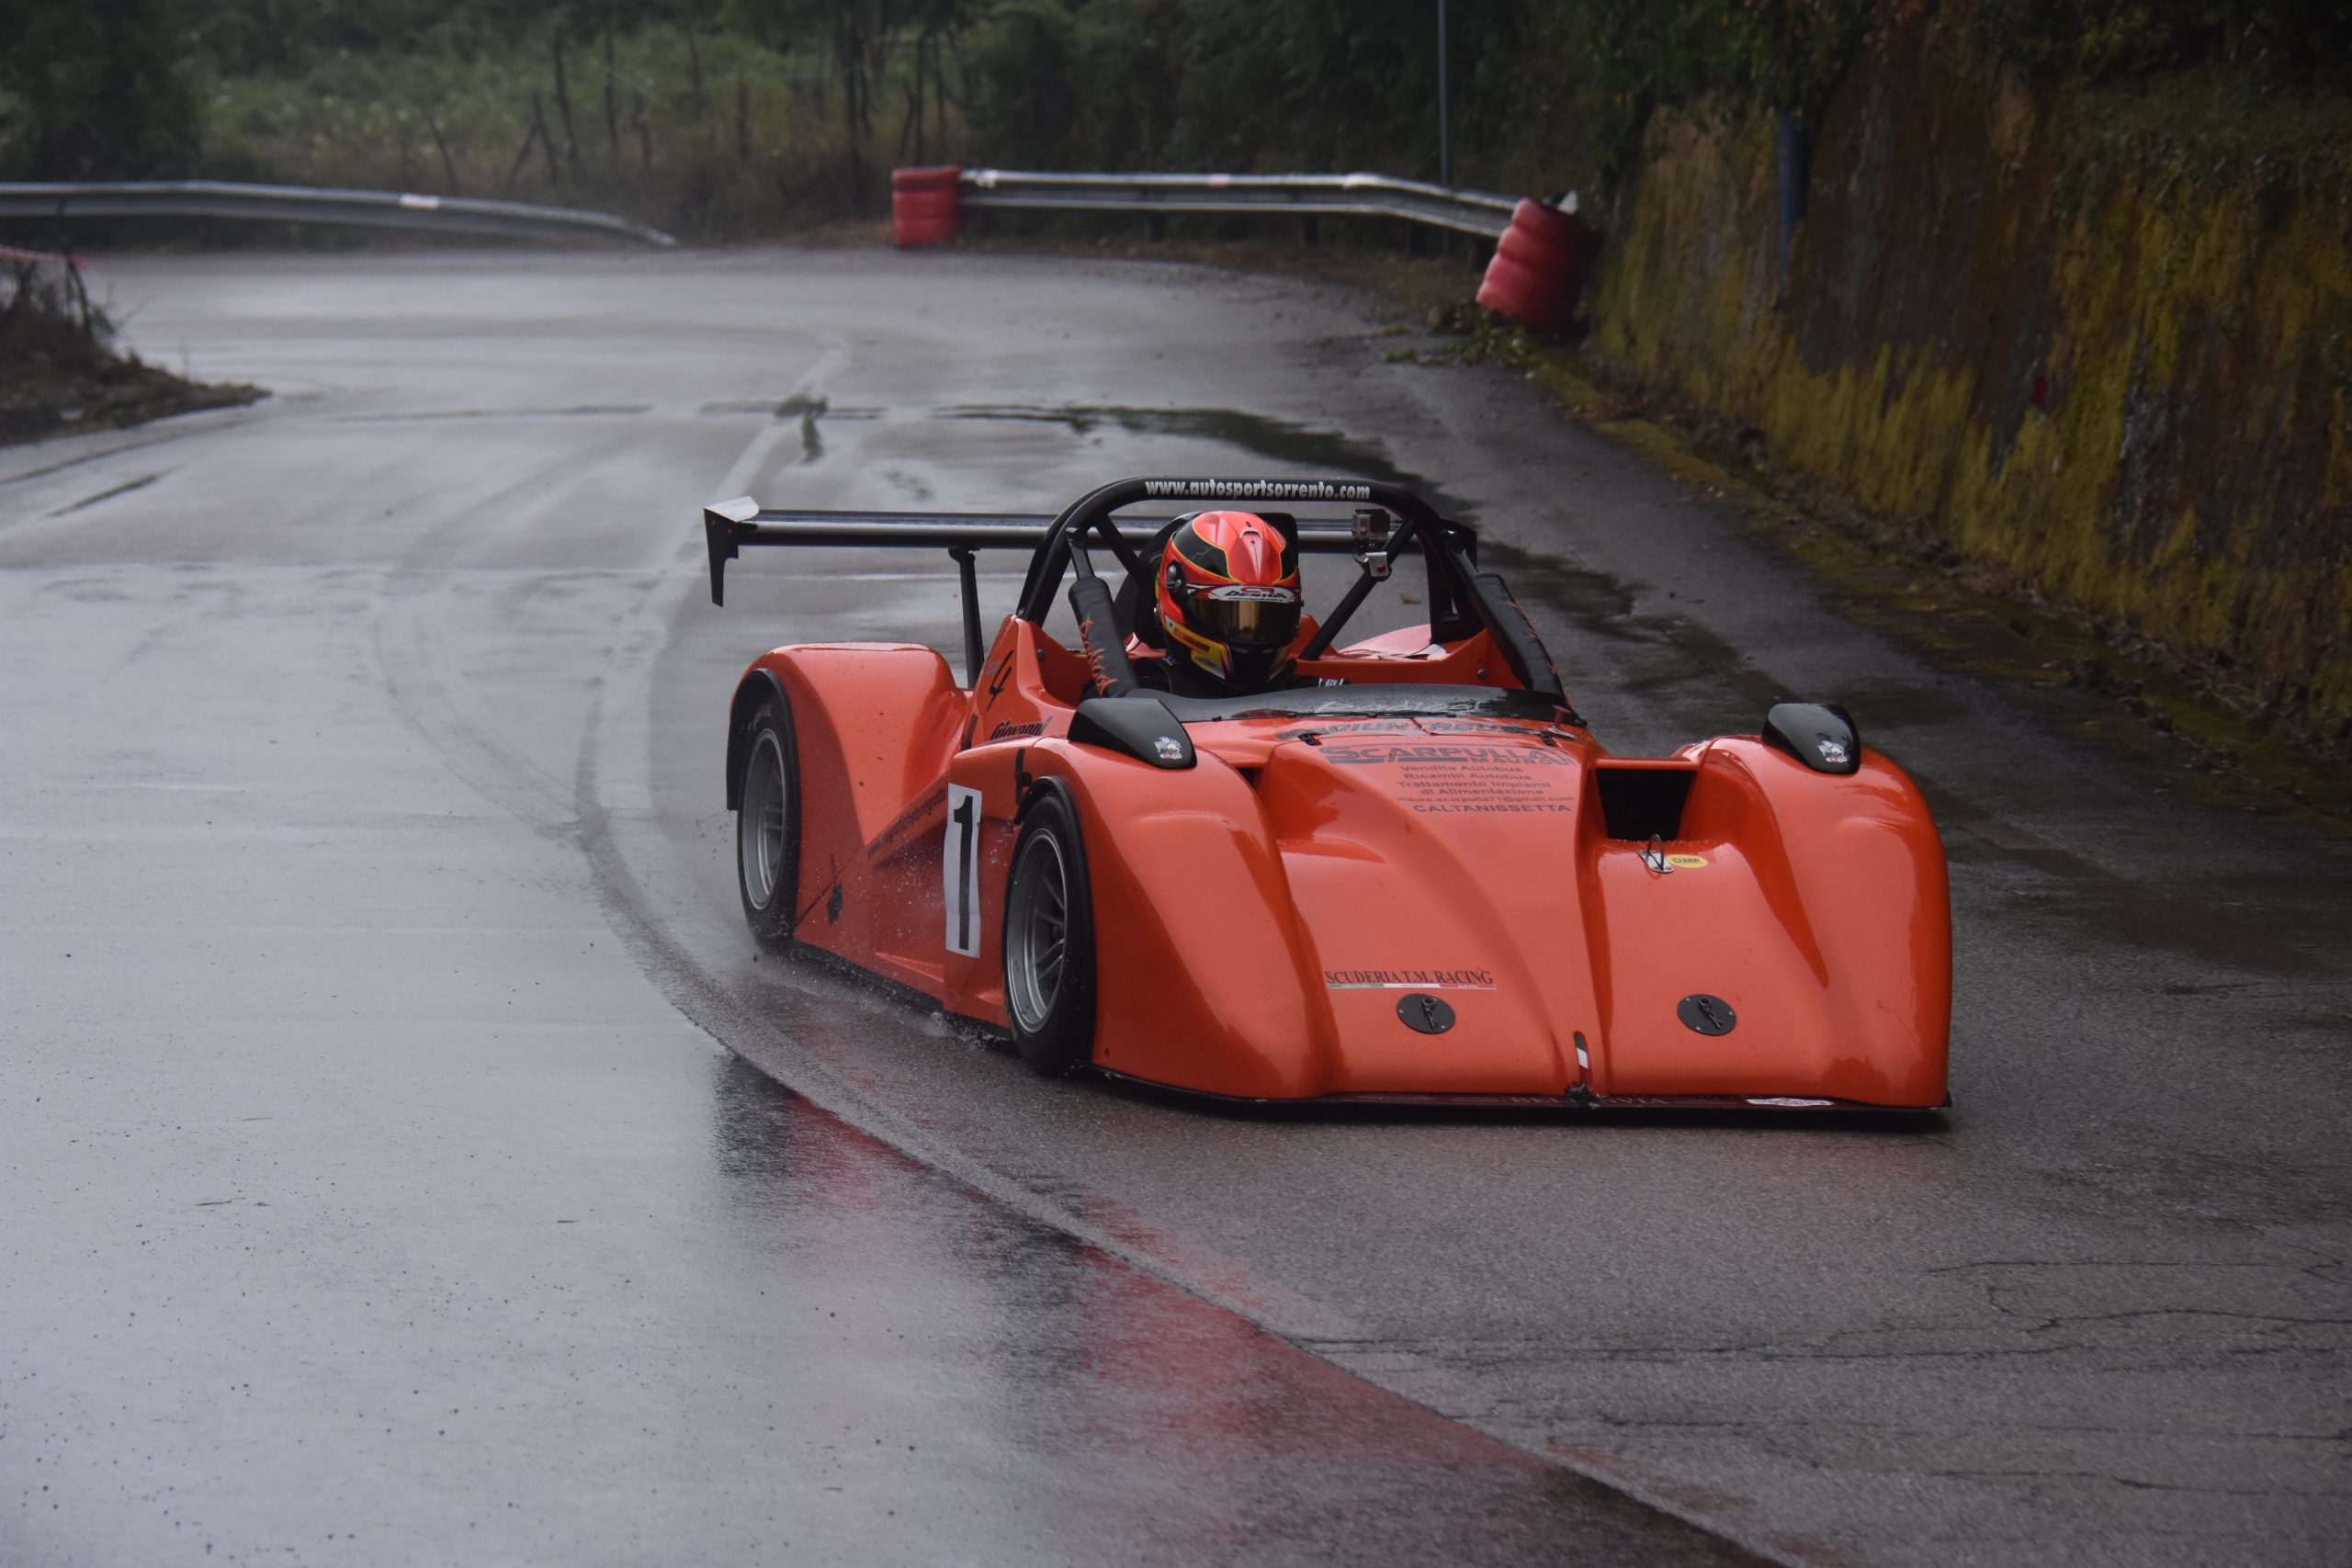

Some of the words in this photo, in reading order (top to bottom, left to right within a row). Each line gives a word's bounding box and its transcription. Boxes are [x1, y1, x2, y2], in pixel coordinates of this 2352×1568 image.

[1145, 479, 1371, 501] www.autosportsorrento.com
[1318, 745, 1566, 764] SCARPULLA
[1469, 757, 1554, 765] MAURO
[1461, 765, 1523, 773] Autobus
[1469, 773, 1532, 781] Autobus
[1491, 781, 1552, 789] Impianti
[1413, 804, 1572, 813] CALTANISSETTA
[953, 795, 974, 951] 1
[1324, 970, 1402, 985] SCUDERIA
[1401, 970, 1433, 985] T.M.
[1434, 970, 1494, 985] RACING
